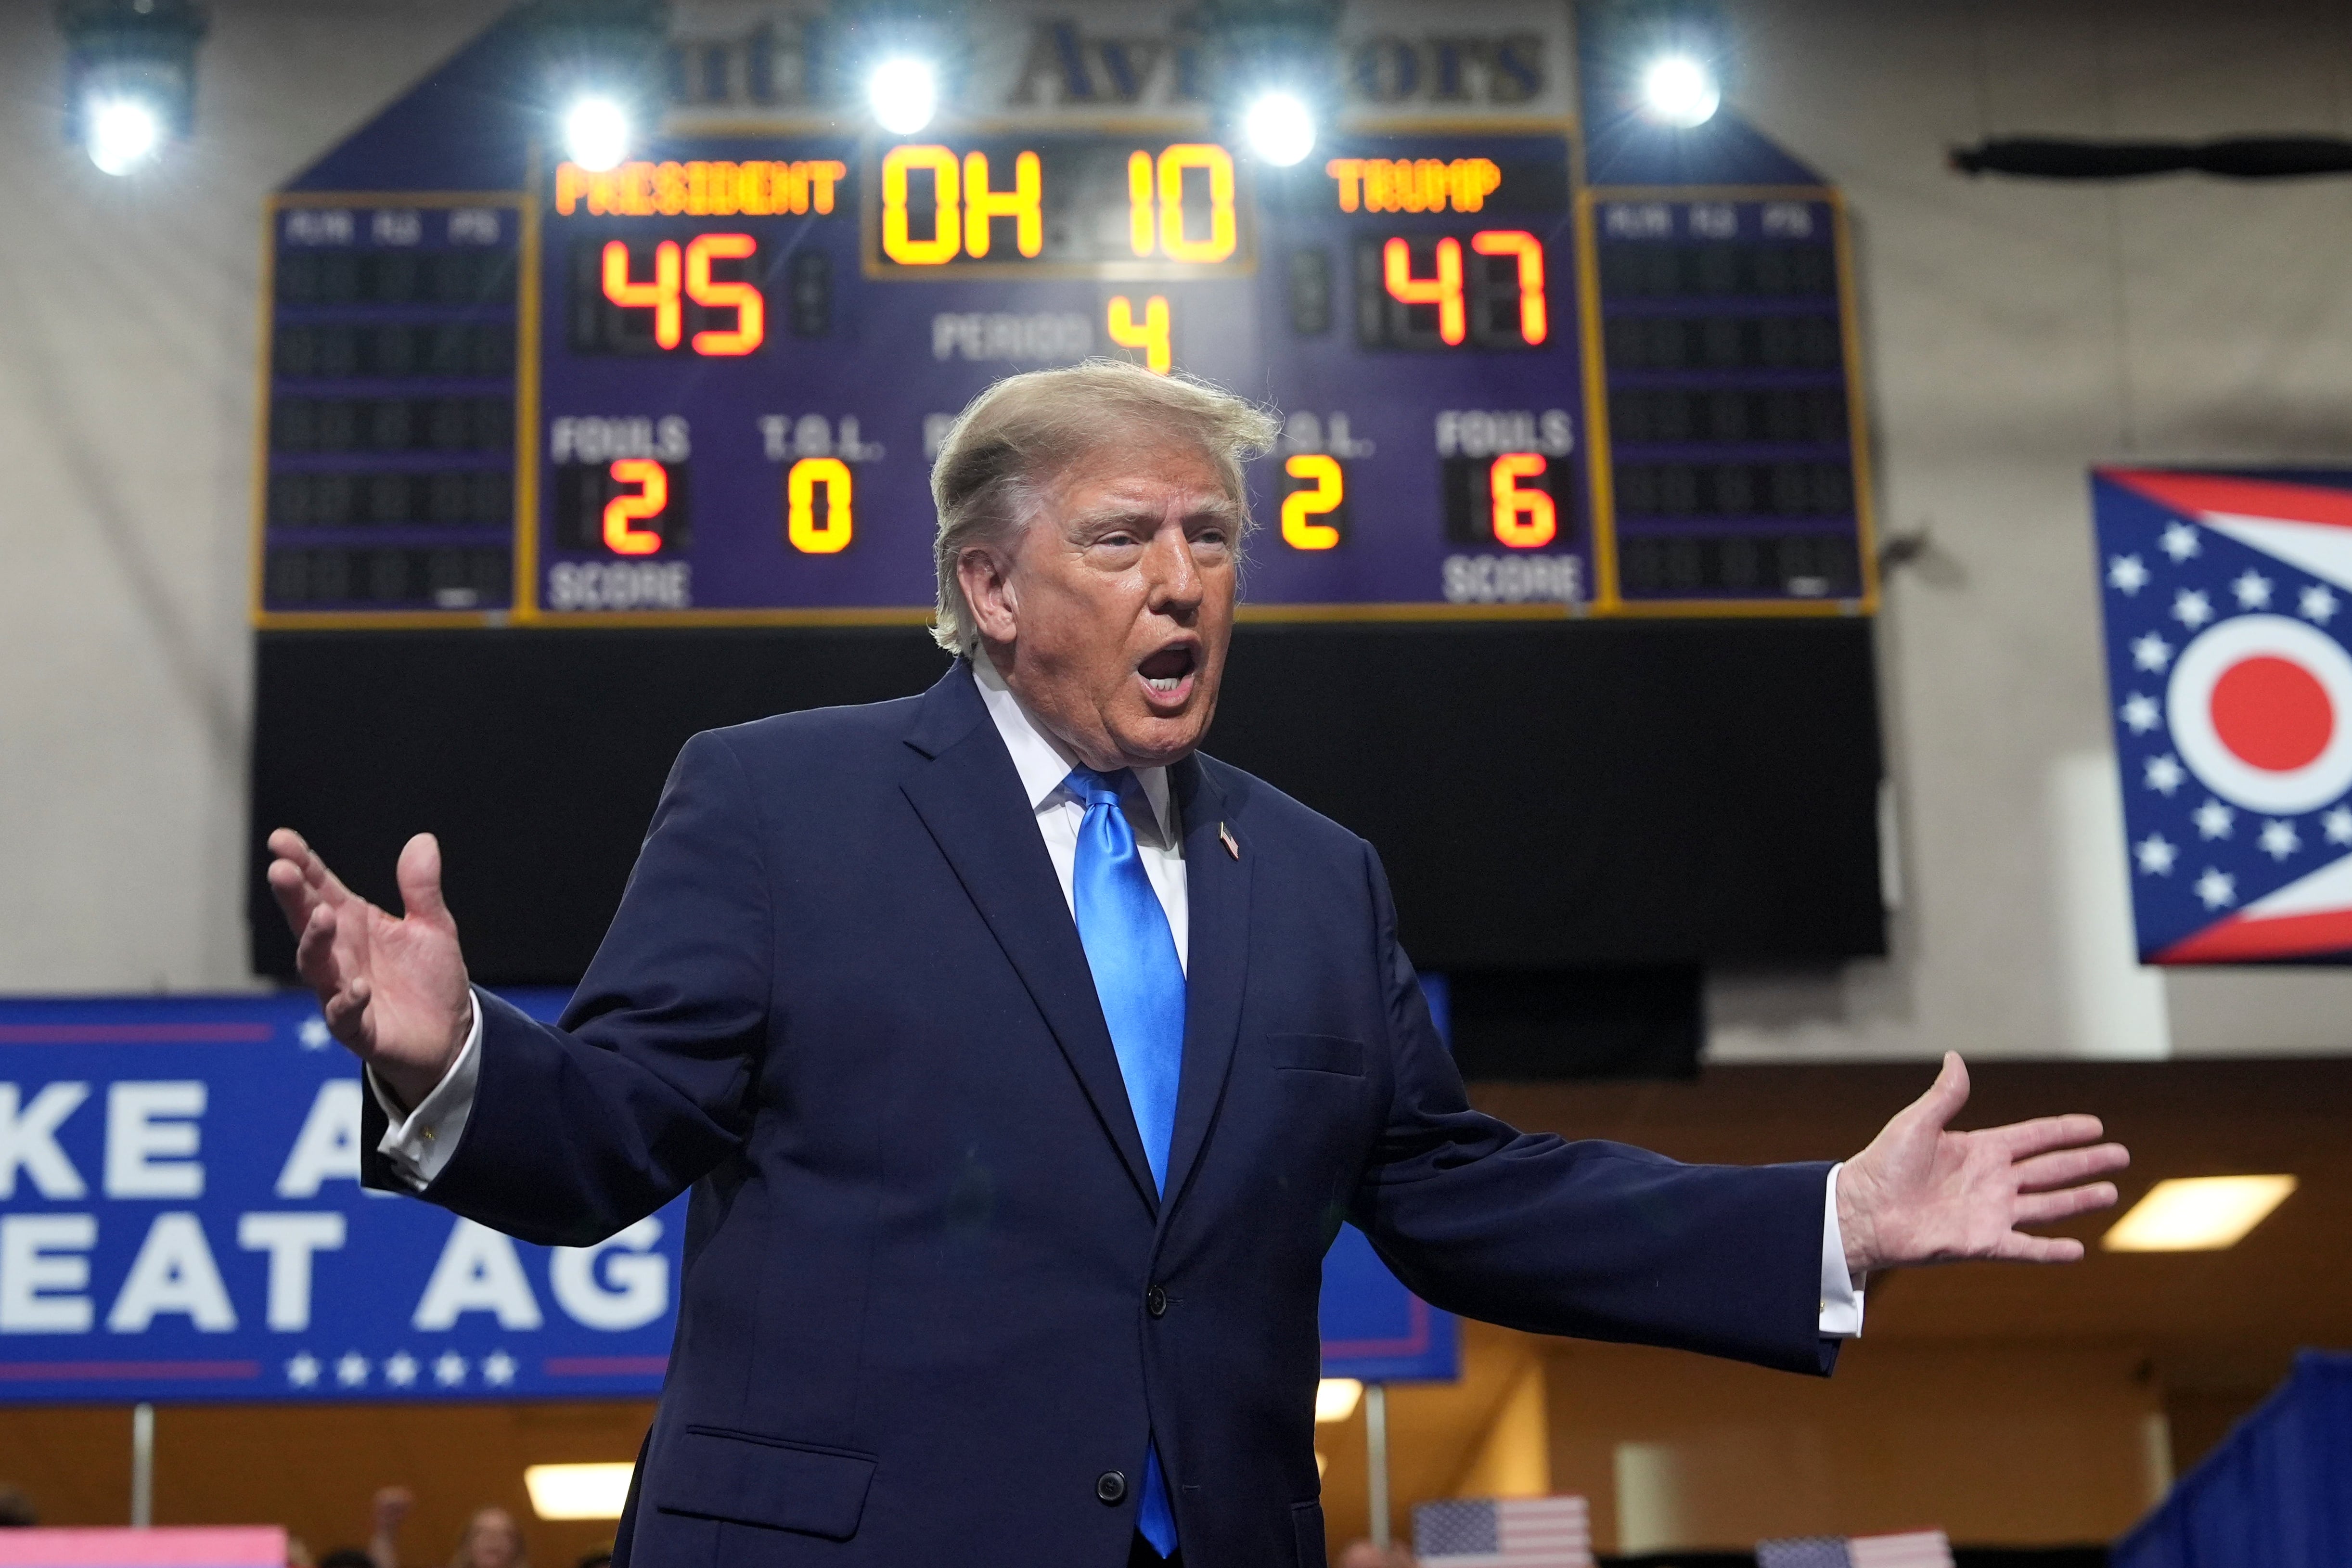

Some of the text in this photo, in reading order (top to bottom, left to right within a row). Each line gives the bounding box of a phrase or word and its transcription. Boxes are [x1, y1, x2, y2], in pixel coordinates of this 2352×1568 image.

[556, 161, 847, 216] PRESIDENT
[1128, 143, 1236, 263] 10
[1326, 158, 1501, 213] TRUMP
[603, 233, 764, 355] 45
[1384, 230, 1546, 345] 47
[931, 312, 1095, 361] PERIOD
[1108, 296, 1170, 375] 4
[550, 415, 691, 462] FOULS
[1436, 411, 1573, 457] FOULS
[603, 458, 667, 555] 2
[788, 458, 852, 553] 0
[1281, 455, 1343, 550] 2
[1490, 452, 1556, 548] 6
[548, 562, 692, 610] SCORE
[1443, 554, 1584, 604] SCORE
[0, 1080, 208, 1199] KE
[0, 1212, 347, 1334] EAT
